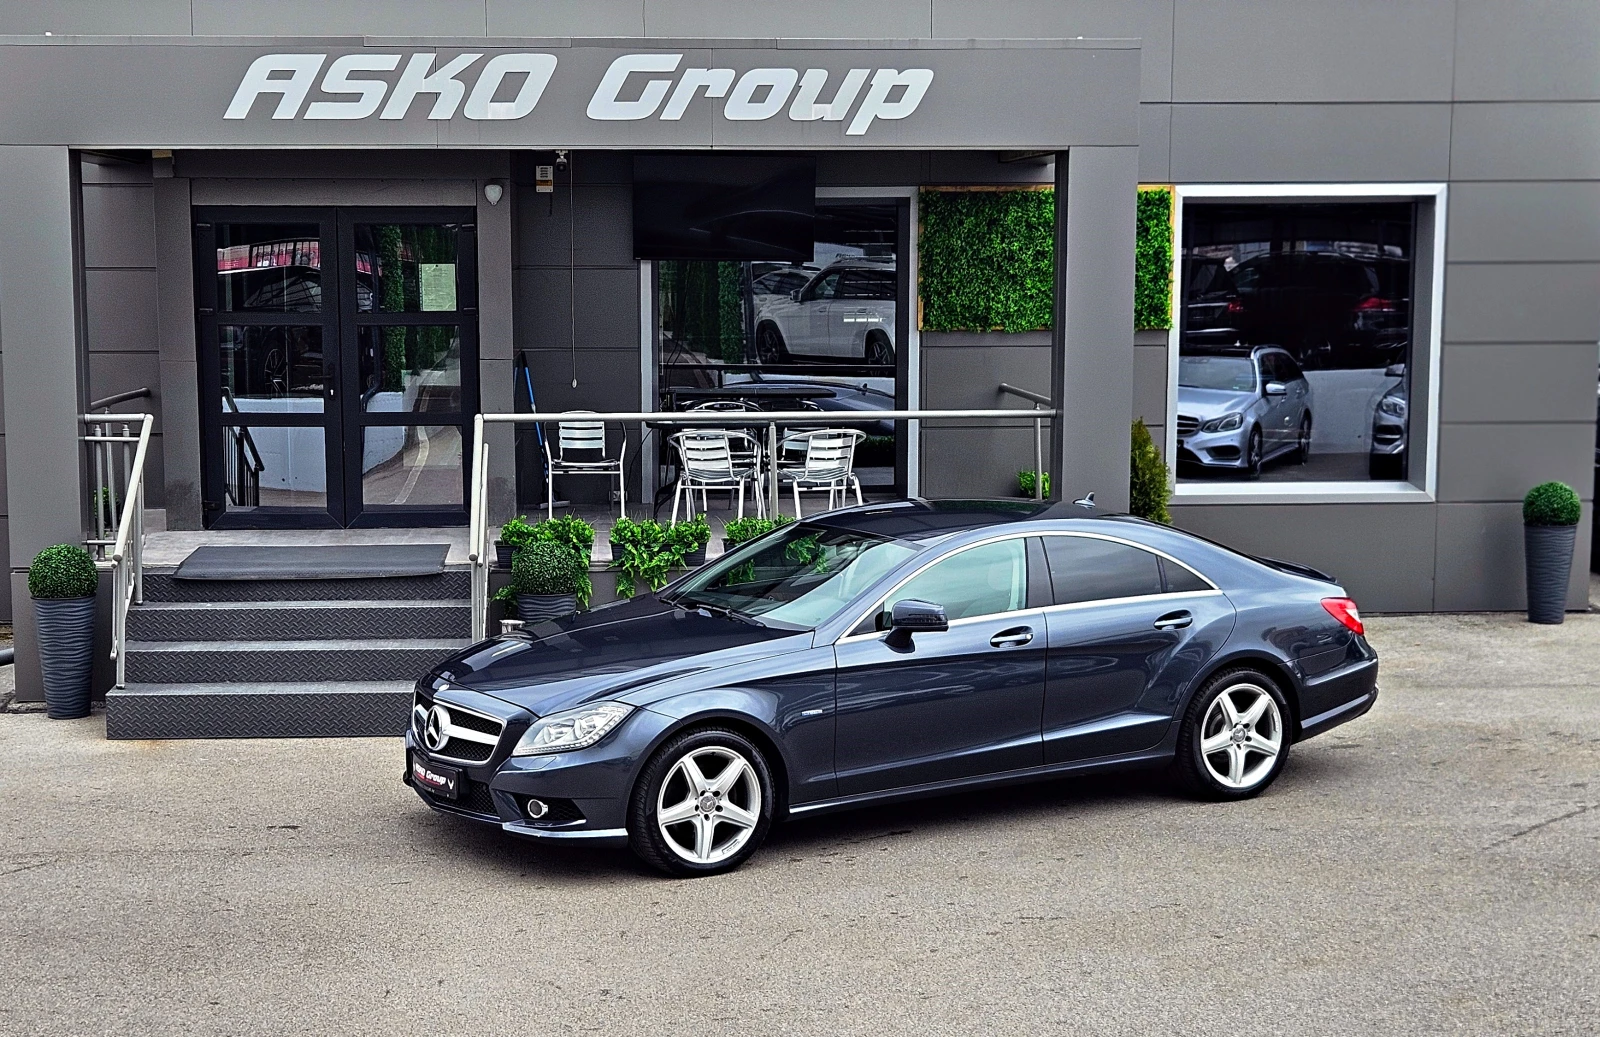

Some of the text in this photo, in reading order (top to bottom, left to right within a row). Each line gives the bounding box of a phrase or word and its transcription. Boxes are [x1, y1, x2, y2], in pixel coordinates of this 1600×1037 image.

[223, 53, 934, 136] ASKO Group
[426, 770, 447, 785] Group
